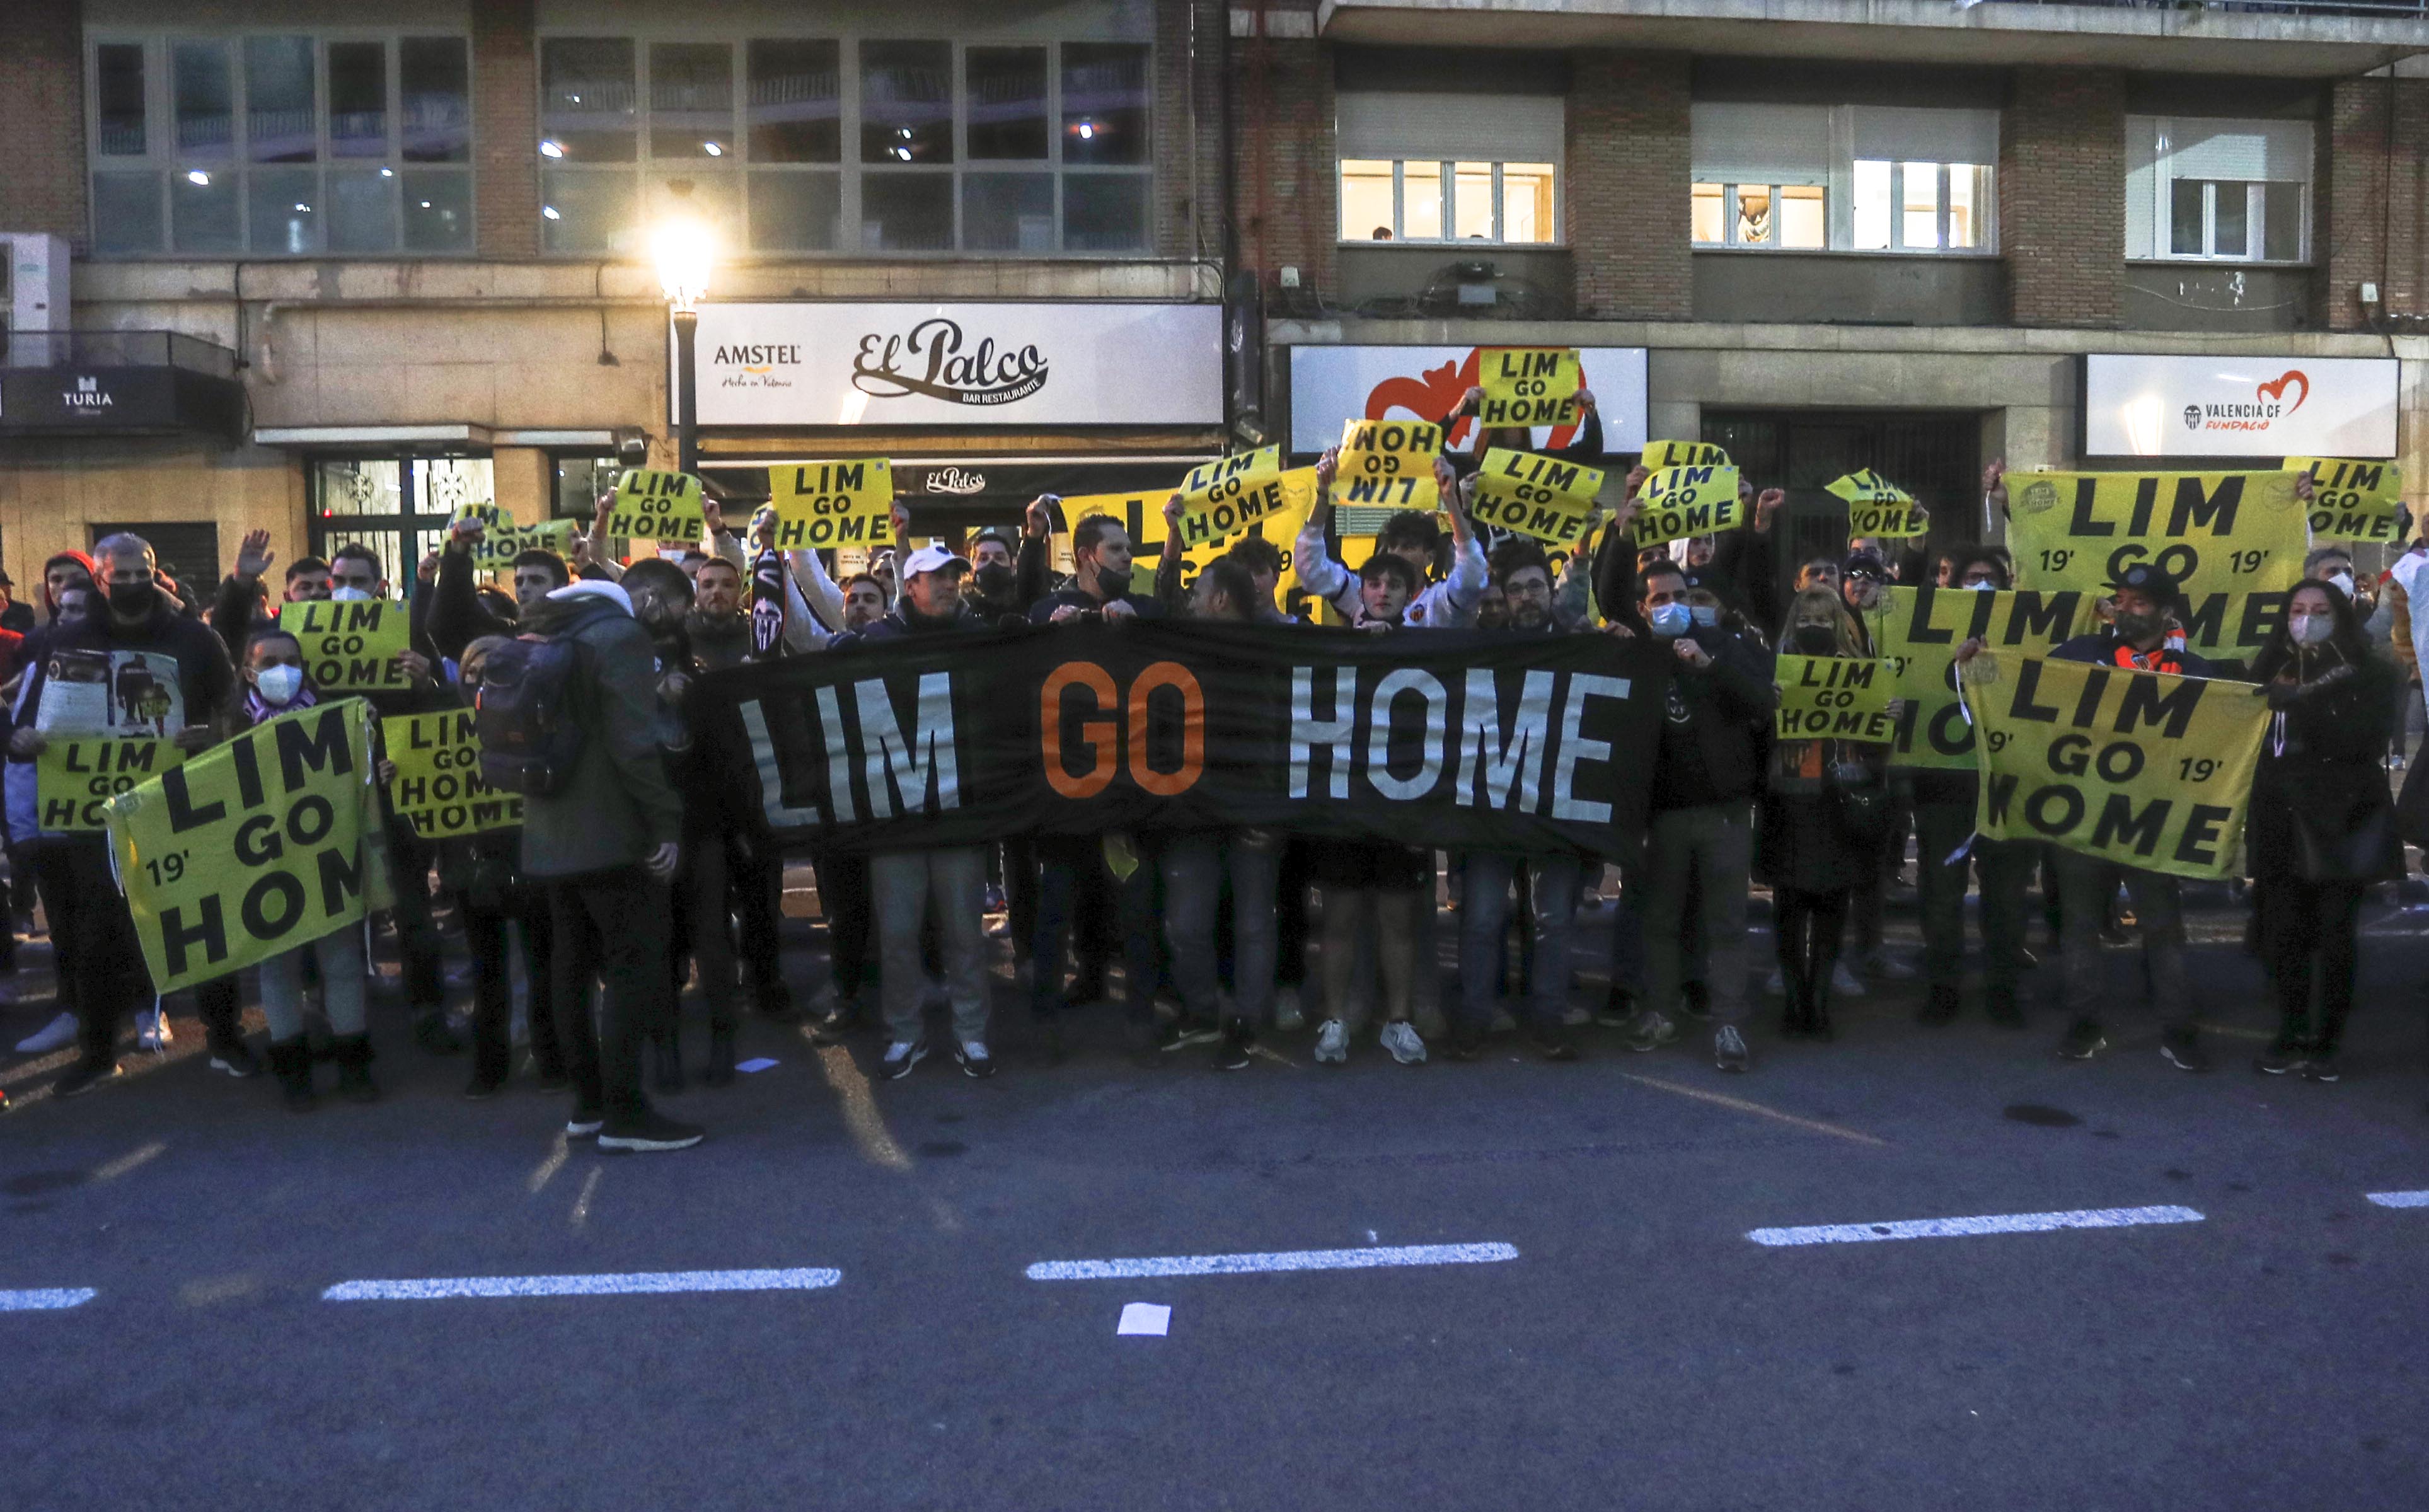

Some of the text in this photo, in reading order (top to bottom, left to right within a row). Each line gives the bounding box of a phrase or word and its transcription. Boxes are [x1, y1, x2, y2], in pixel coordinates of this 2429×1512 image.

[714, 345, 801, 364] AMSTEL
[852, 318, 1047, 387] El Palco
[1501, 353, 1559, 378] LIM
[63, 393, 113, 407] TURIA
[962, 379, 1041, 404] BAR RESTAURANTE
[1515, 379, 1546, 396] GO
[1485, 398, 1573, 423] HOME
[2205, 404, 2281, 418] VALENCIA CF
[2205, 420, 2270, 432] FUNDACIÓ
[1364, 454, 1400, 474] GO
[1663, 443, 1726, 466] LIM
[628, 472, 688, 497] LIM
[795, 462, 865, 495] LIM
[926, 466, 985, 489] El Palco
[1190, 452, 1255, 492] LIM
[1504, 453, 1579, 492] LIM
[1649, 466, 1714, 499] LIM
[2310, 461, 2383, 491] LIM
[1208, 476, 1241, 504] GO
[1347, 475, 1417, 504] LIM
[1515, 483, 1552, 504] GO
[1661, 488, 1697, 509] GO
[2317, 490, 2360, 509] GO
[640, 497, 672, 514] GO
[813, 495, 851, 515] GO
[1187, 481, 1283, 541] HOME
[1475, 492, 1583, 540] HOME
[2068, 475, 2246, 537] LIM
[611, 514, 701, 538] HOME
[780, 514, 890, 546] HOME
[1636, 500, 1734, 543] HOME
[2309, 511, 2394, 538] OME
[2040, 543, 2269, 585] 19' GO 19'
[301, 603, 383, 633] LIM
[1907, 585, 2082, 645] LIM
[321, 635, 364, 655] GO
[304, 659, 404, 686] OME
[1800, 660, 1876, 689] LIM
[1815, 690, 1855, 708] GO
[2009, 659, 2208, 739] LIM
[1781, 709, 1888, 737] HOME
[66, 742, 156, 773] LIM
[433, 746, 476, 770] GO
[739, 661, 1631, 828] LIM GO HOME
[2047, 734, 2145, 783] GO
[2179, 758, 2223, 783] 19'
[161, 707, 353, 834] LIM
[88, 776, 135, 796] GO
[400, 770, 494, 807] HOM
[234, 794, 335, 867] GO
[1987, 771, 2232, 865] HOME
[146, 849, 189, 886] 19'
[159, 838, 364, 978] HOM
